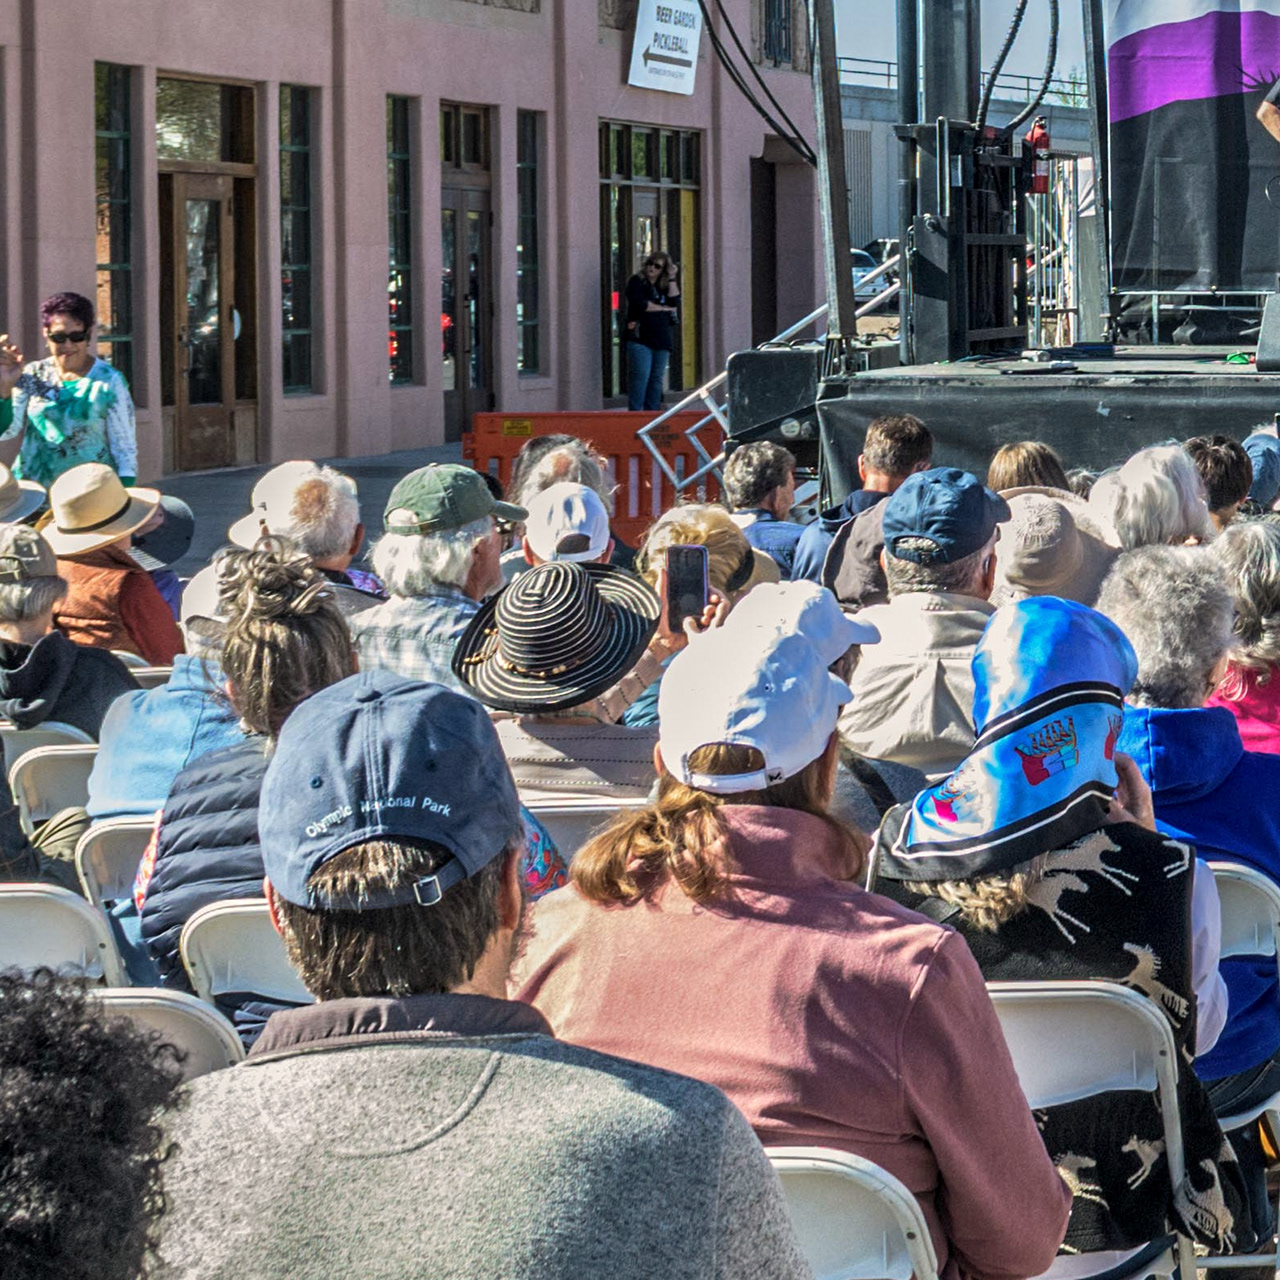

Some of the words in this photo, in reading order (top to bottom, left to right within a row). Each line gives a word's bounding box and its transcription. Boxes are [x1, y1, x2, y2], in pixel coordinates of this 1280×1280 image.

[305, 804, 354, 838] Olympic
[360, 796, 416, 814] National
[421, 797, 452, 817] Park
